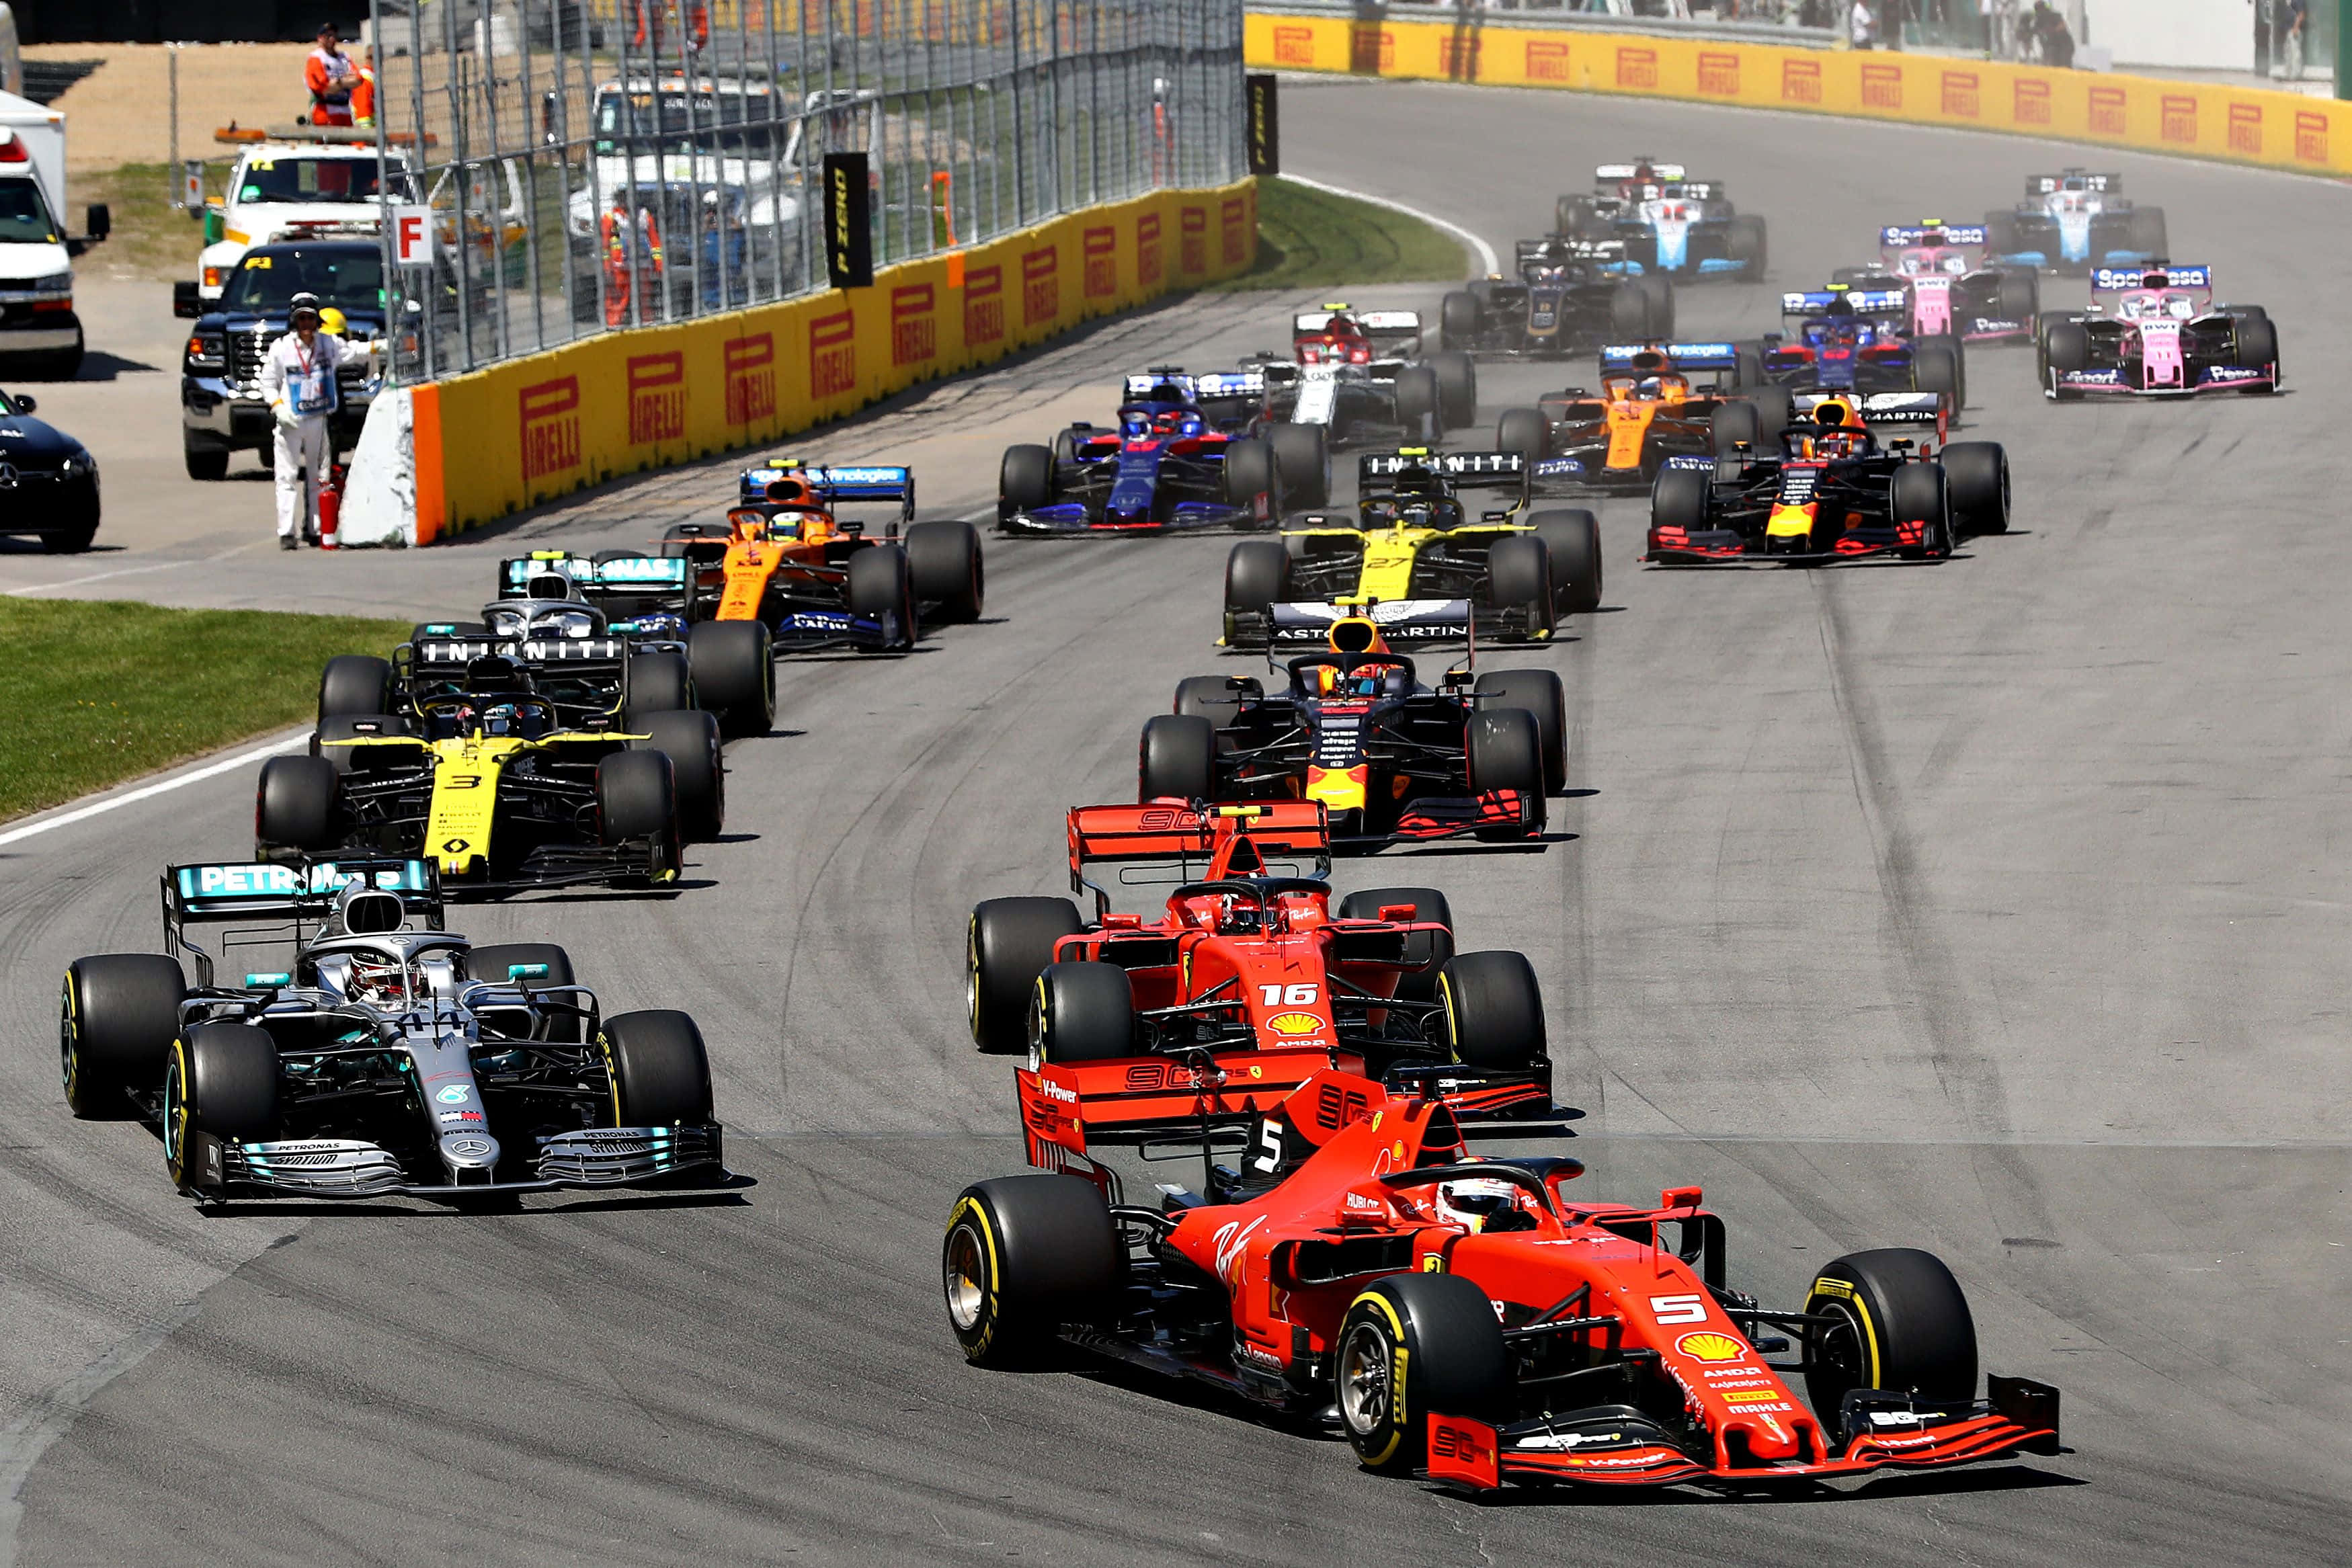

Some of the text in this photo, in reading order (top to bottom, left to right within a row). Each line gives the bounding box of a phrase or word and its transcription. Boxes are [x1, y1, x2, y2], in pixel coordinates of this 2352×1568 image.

[834, 167, 848, 248] ZERO
[399, 217, 422, 258] F
[891, 282, 936, 368] PIRELLI
[809, 309, 856, 401] PIRELLI
[725, 335, 776, 425] PIRELLI
[626, 349, 684, 446] PIRELLI
[519, 374, 581, 482] PIRELLI
[1367, 557, 1412, 568] 27
[444, 776, 482, 789] 3
[1258, 983, 1318, 1007] 16
[395, 1012, 465, 1032] 44
[1275, 1040, 1316, 1048] AMD
[1043, 1078, 1077, 1104] V-Power
[278, 1143, 339, 1151] PETRONAS
[1254, 1118, 1283, 1173] 5
[1815, 1277, 1855, 1300] PIRELLI
[1648, 1293, 1709, 1325] 5
[1703, 1366, 1749, 1378] AMD
[1727, 1402, 1793, 1415] MAHLE
[1729, 1392, 1773, 1401] PIRELLI
[1588, 1452, 1666, 1466] V-Power
